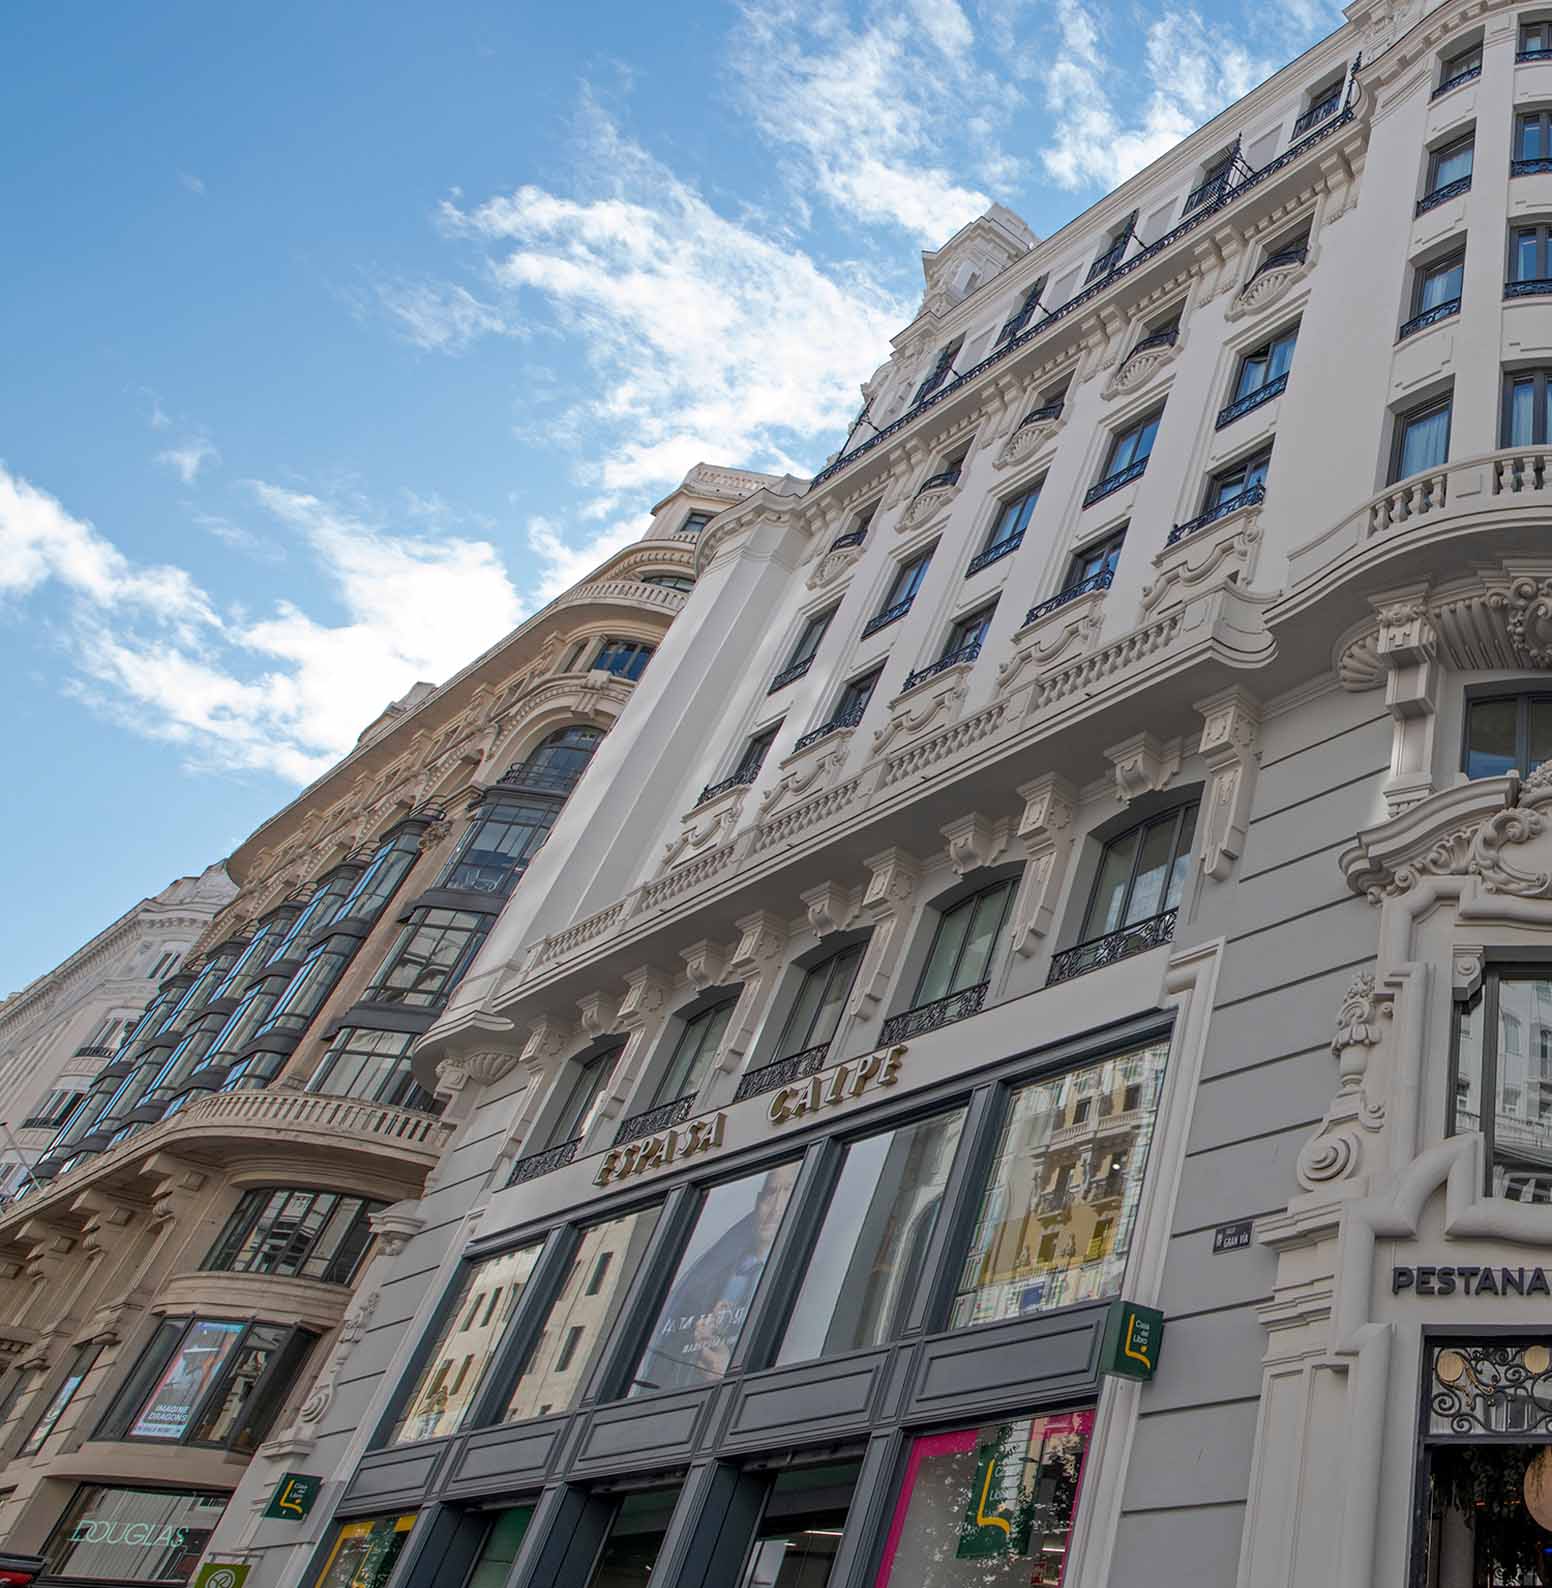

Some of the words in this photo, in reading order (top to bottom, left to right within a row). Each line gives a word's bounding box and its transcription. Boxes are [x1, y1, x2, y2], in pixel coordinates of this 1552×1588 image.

[592, 1112, 727, 1188] ESPASA
[767, 1045, 908, 1124] CALPE
[1223, 1235, 1239, 1249] GRAN
[1391, 1266, 1551, 1296] PESTANA
[69, 1519, 190, 1549] DOUGLAS
